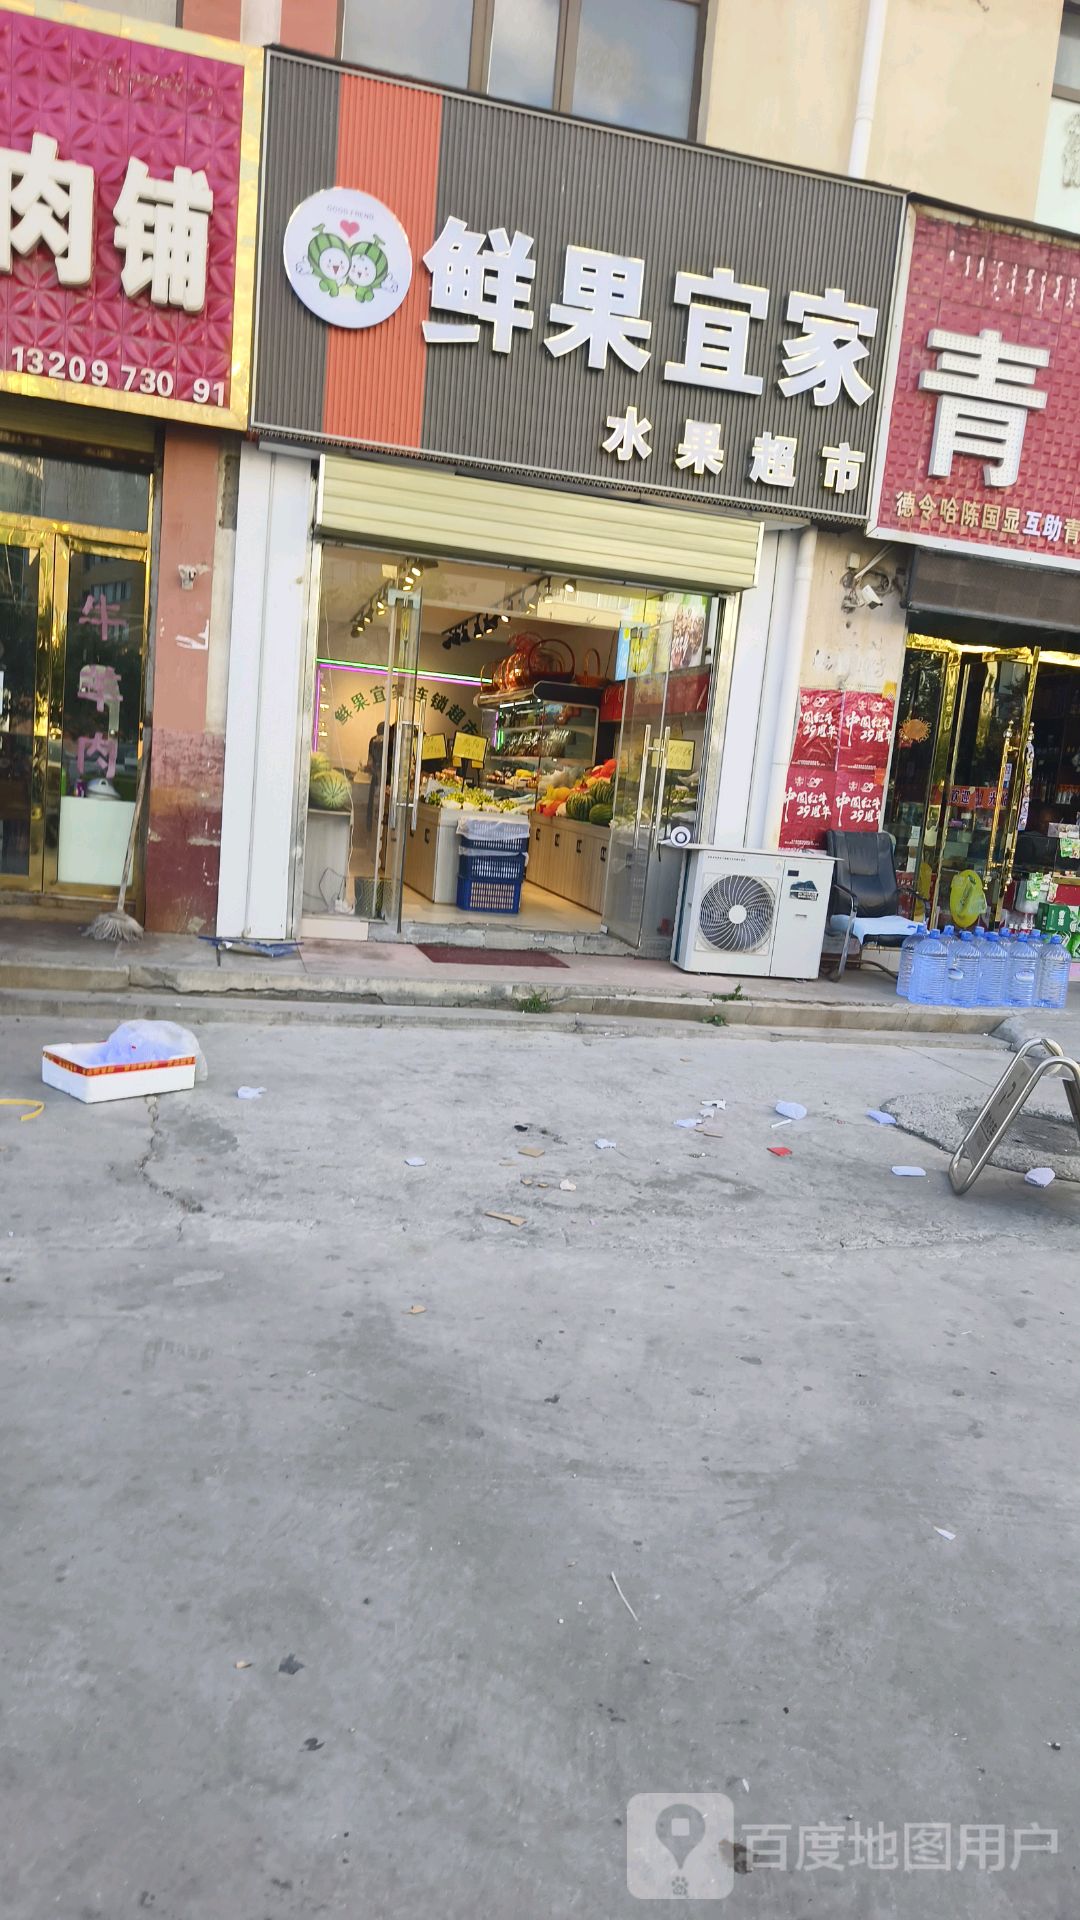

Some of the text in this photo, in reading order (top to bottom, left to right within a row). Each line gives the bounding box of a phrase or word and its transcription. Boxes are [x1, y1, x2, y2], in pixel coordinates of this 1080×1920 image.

[0, 132, 213, 312] 肉铺
[422, 216, 878, 407] 鲜果宜家
[11, 346, 225, 407] 13209 730 91
[918, 328, 1050, 487] 青
[602, 406, 865, 494] 水果超市
[800, 711, 833, 726] 国红牛
